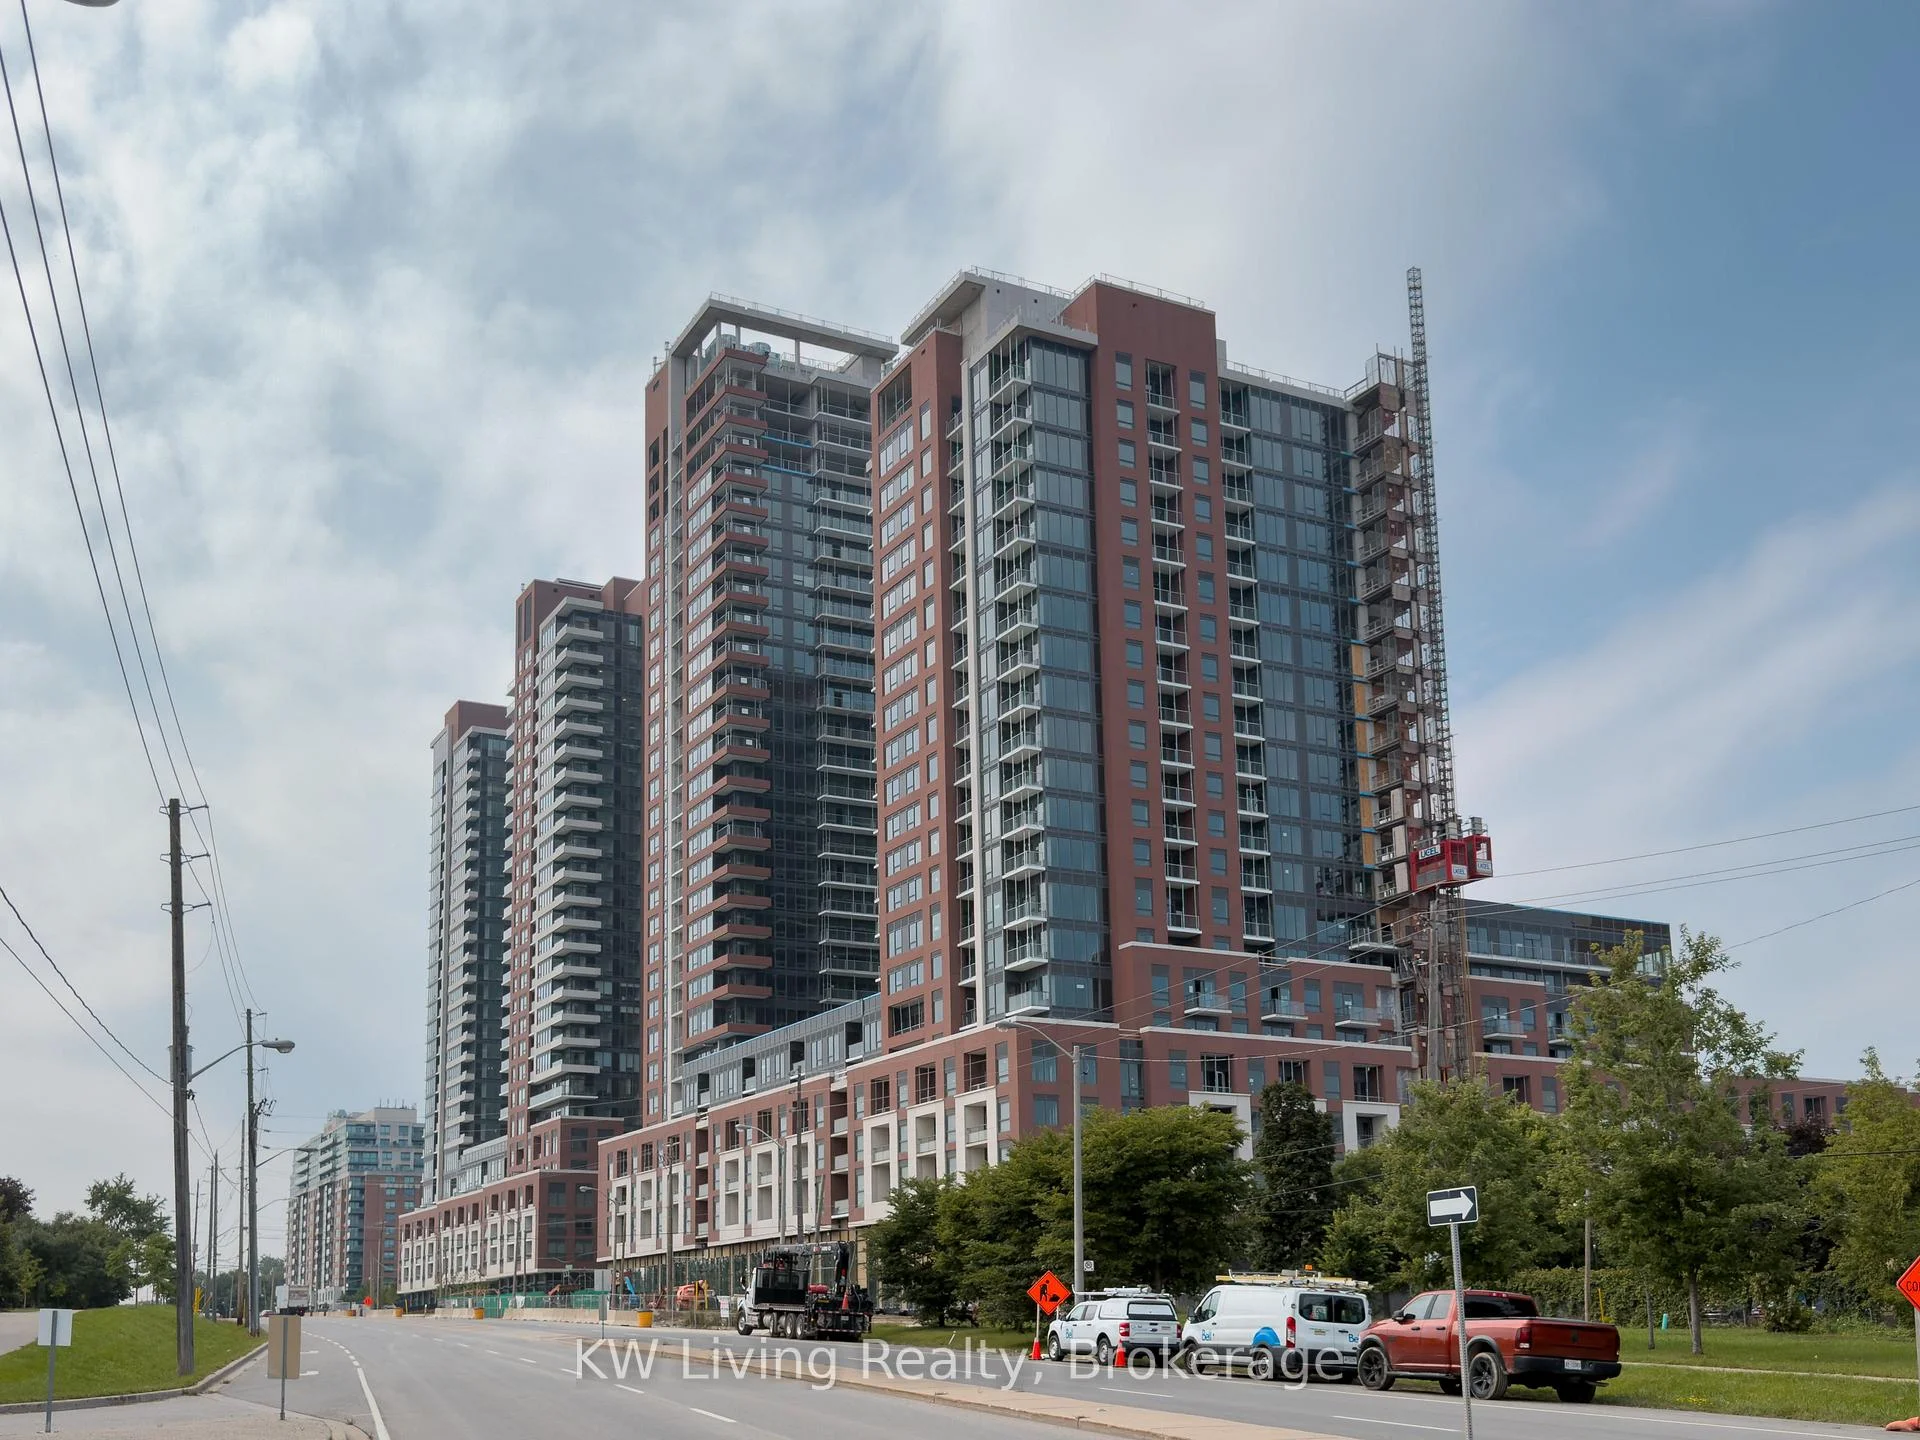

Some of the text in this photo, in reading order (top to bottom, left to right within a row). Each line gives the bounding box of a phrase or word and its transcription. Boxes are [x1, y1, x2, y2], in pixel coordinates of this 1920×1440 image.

[1906, 1281, 1920, 1292] CO
[1201, 1329, 1212, 1341] Bell
[1348, 1333, 1360, 1343] Be
